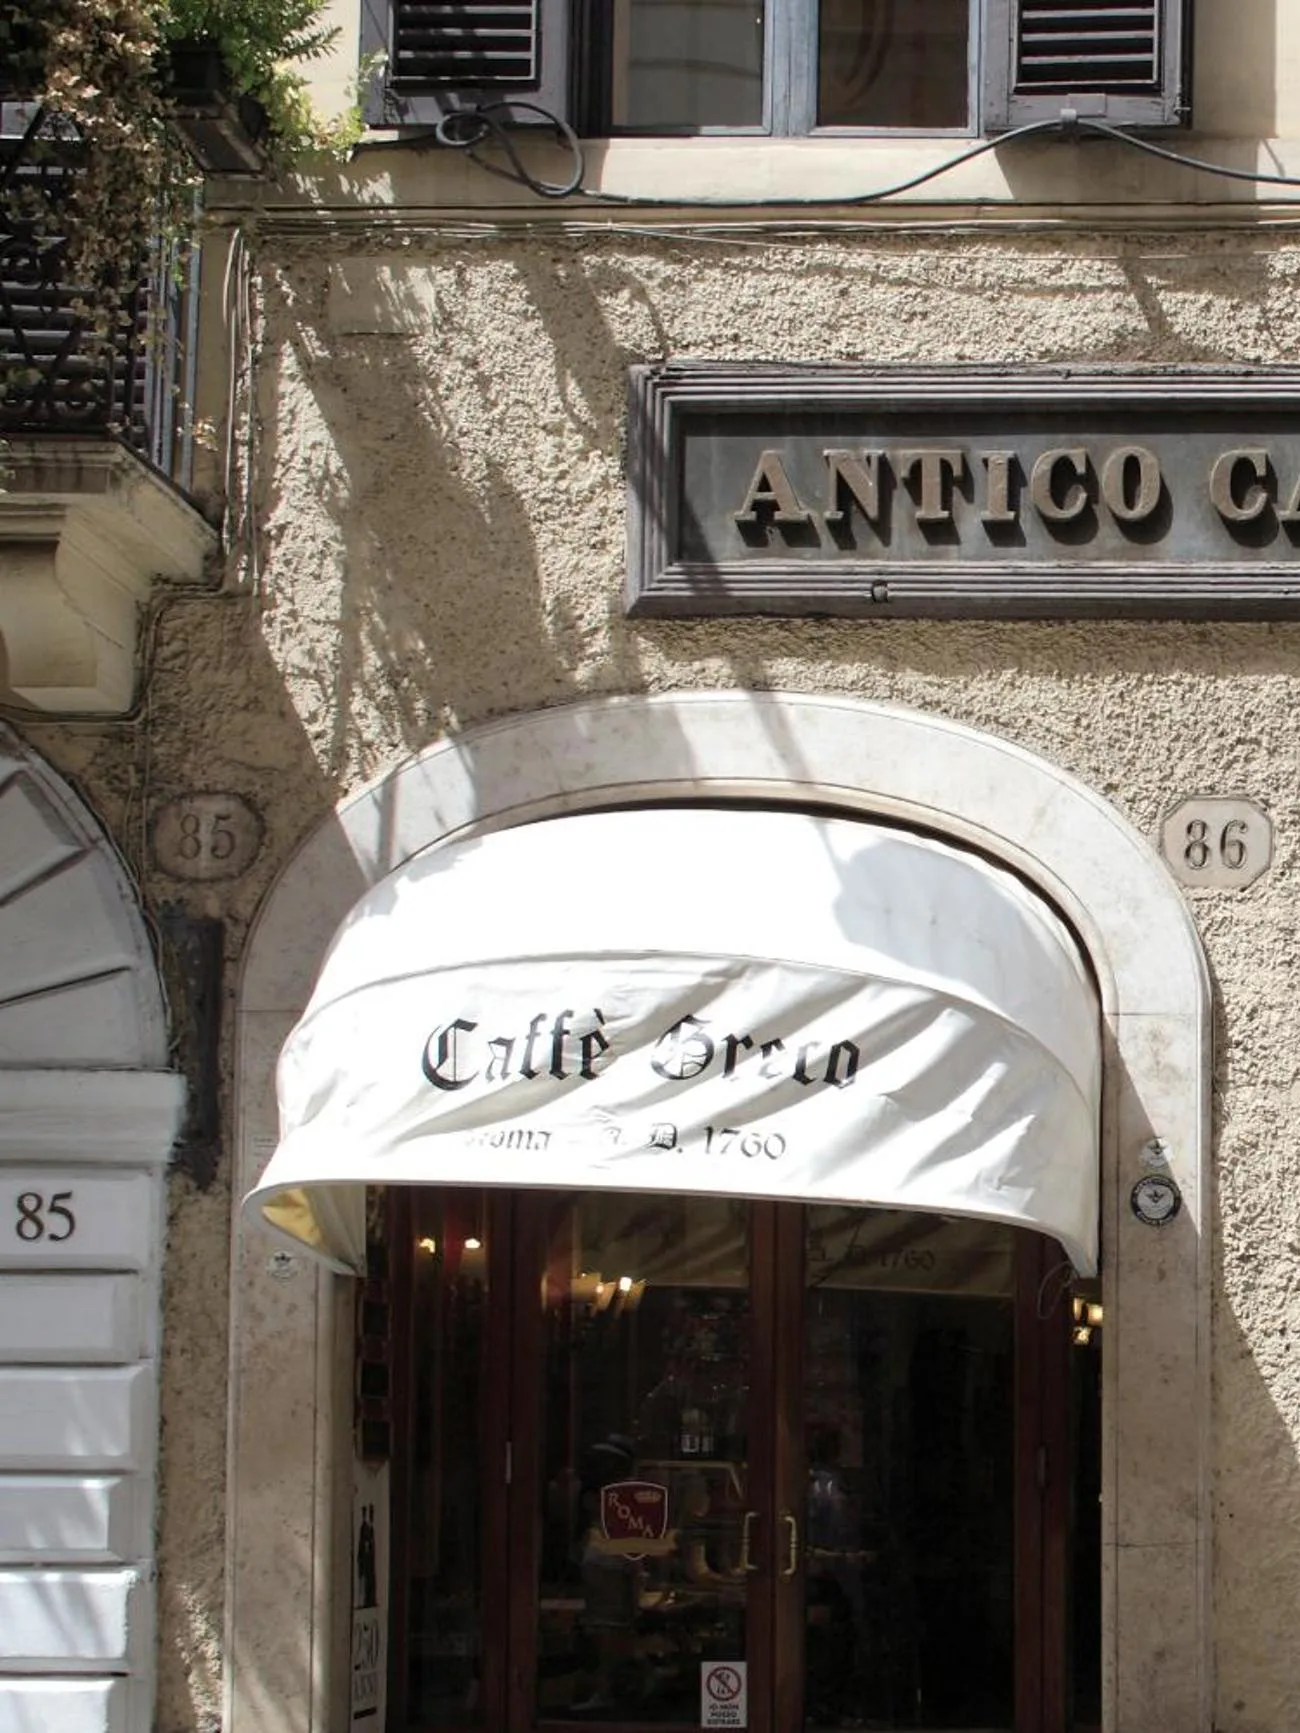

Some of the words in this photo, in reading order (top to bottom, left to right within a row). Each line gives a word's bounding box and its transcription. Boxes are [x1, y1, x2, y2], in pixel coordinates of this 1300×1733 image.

[734, 446, 1160, 523] ANTICO
[180, 813, 236, 861] 85
[1184, 819, 1248, 870] 86
[421, 1007, 610, 1092] Caffè
[651, 1013, 861, 1090] Greco
[465, 1128, 552, 1151] oma
[703, 1125, 787, 1160] 1760
[15, 1190, 77, 1243] 85
[607, 1491, 655, 1538] ROMA
[353, 1618, 379, 1671] 250
